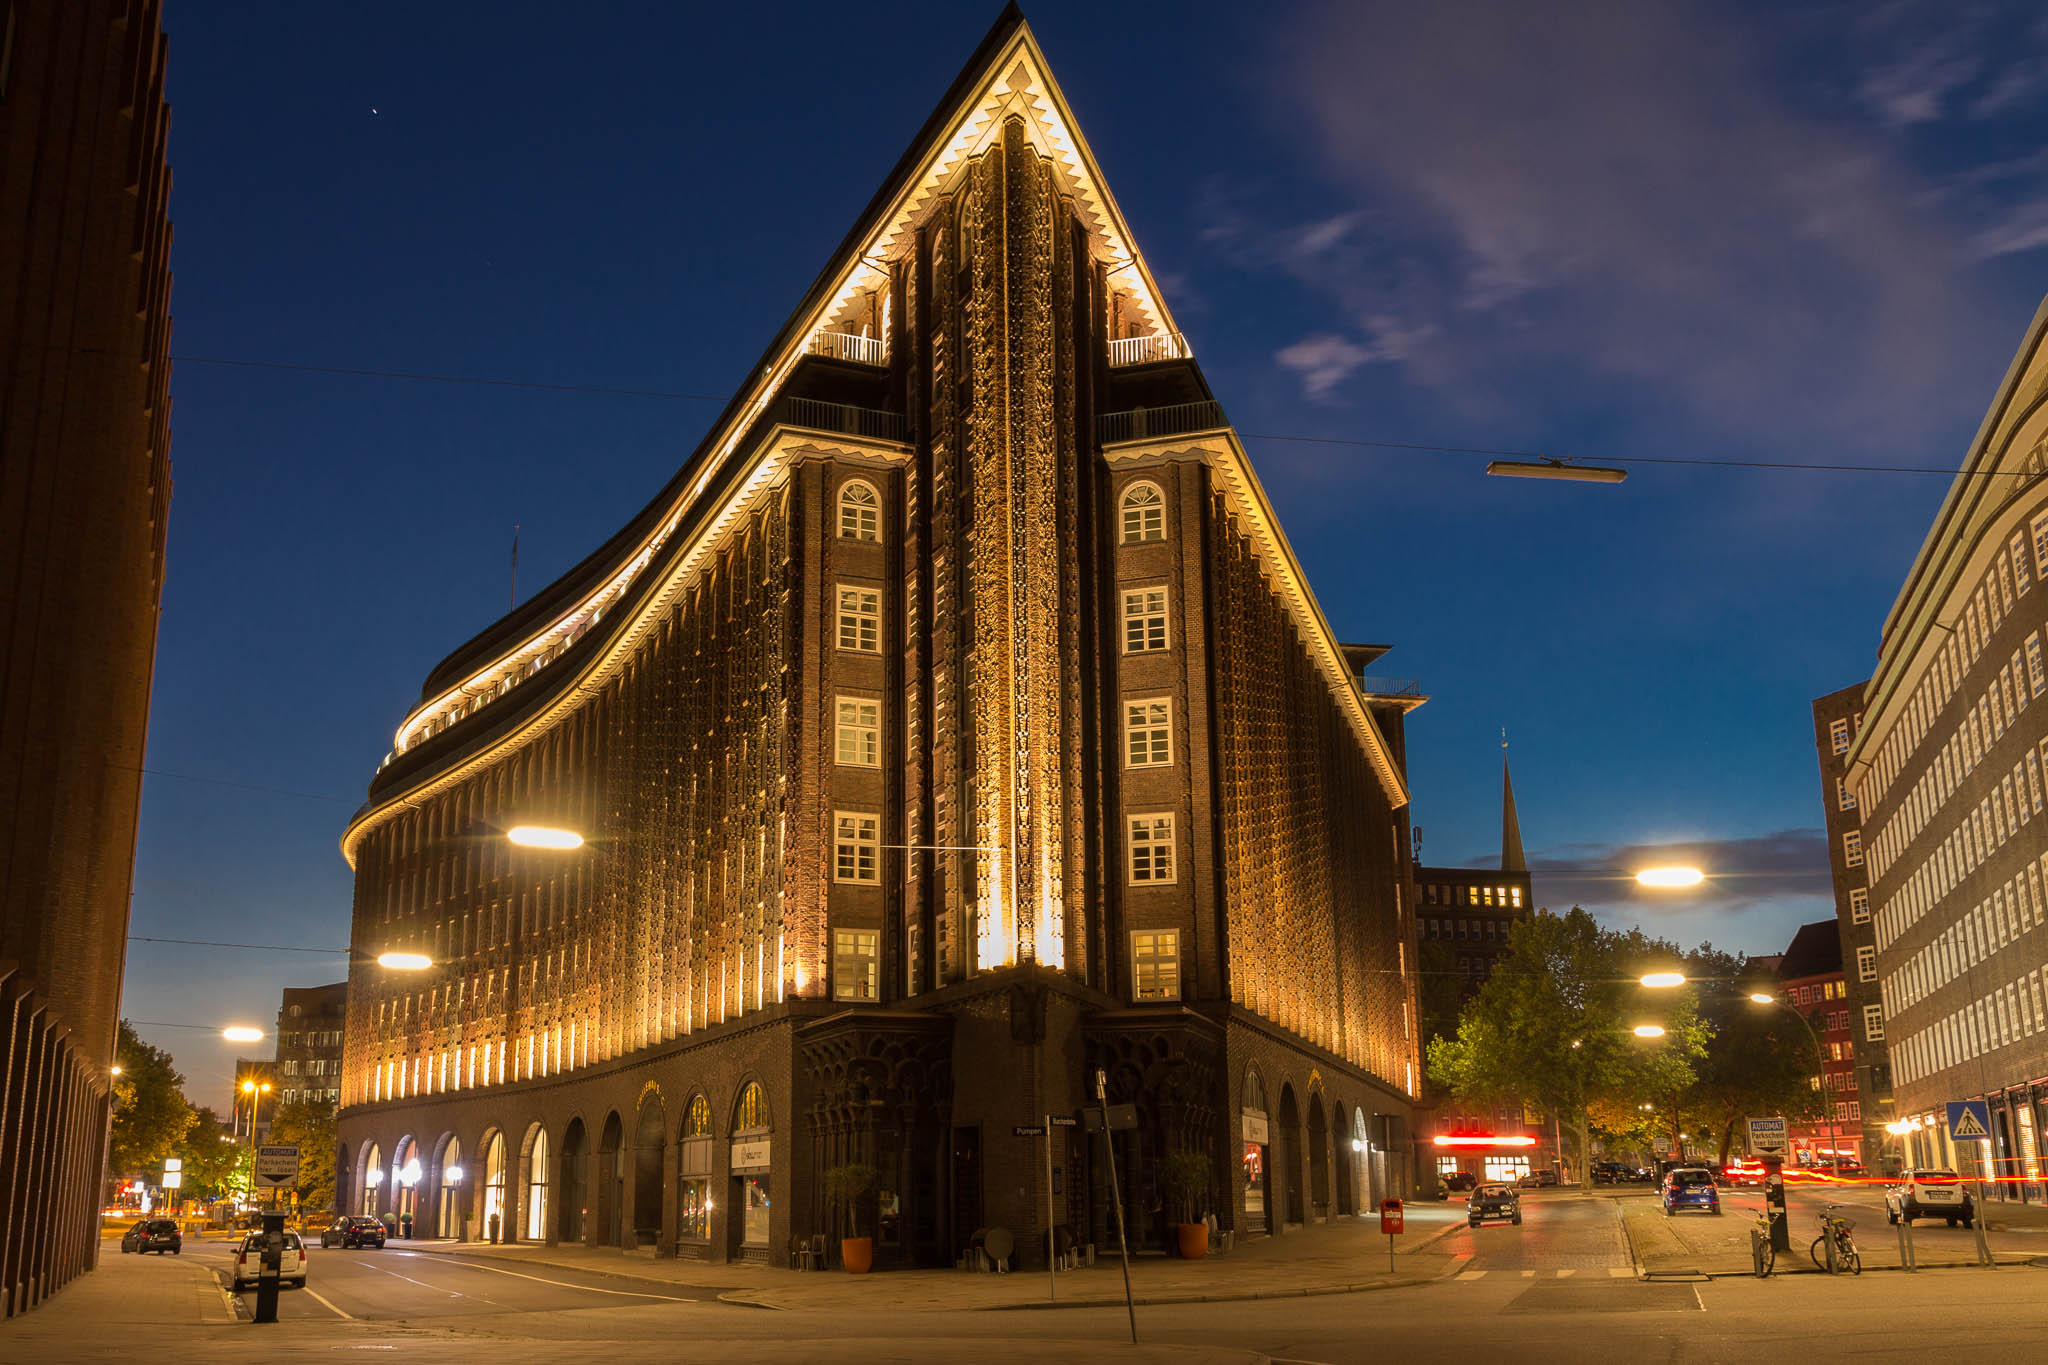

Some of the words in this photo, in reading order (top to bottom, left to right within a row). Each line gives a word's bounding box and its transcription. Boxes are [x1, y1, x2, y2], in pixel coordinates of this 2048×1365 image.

[1752, 1121, 1783, 1130] AUTOMAT
[1016, 1127, 1042, 1136] Pumpen
[262, 1148, 296, 1156] AUTOMAT
[259, 1158, 297, 1166] Parkschein
